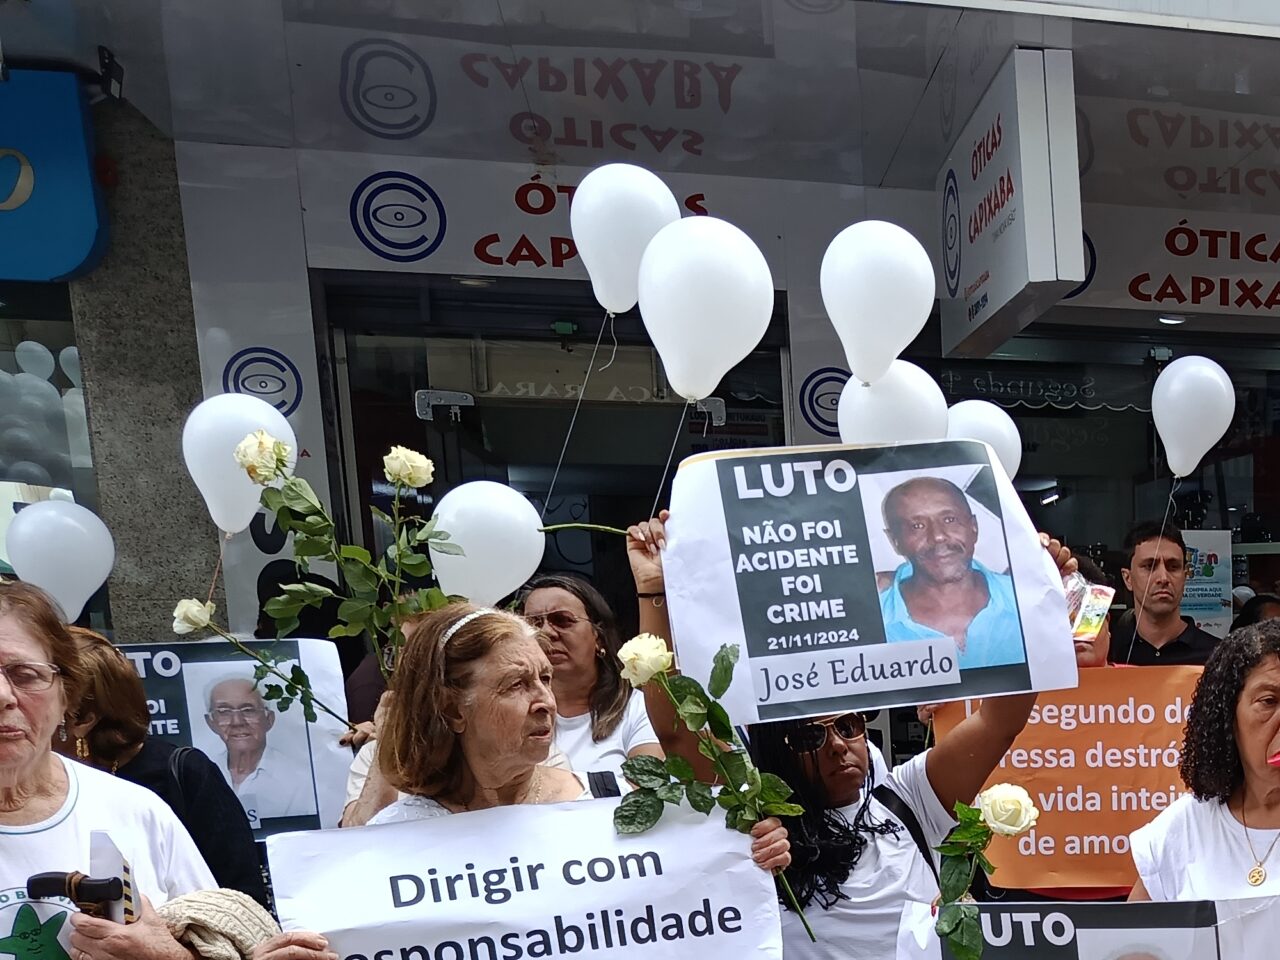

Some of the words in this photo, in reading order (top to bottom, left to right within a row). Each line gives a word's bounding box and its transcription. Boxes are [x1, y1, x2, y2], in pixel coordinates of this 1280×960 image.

[971, 112, 1003, 181] ÓTICAS
[968, 167, 1014, 244] CAPIXABA
[733, 459, 857, 500] LUTO
[741, 519, 797, 545] NÃO
[801, 519, 843, 541] FOI
[736, 544, 859, 573] ACIDENTE
[781, 574, 823, 596] FOI
[766, 598, 846, 624] CRIME
[767, 628, 860, 650] 21/11/2024
[759, 662, 820, 702] José
[827, 646, 953, 685] Eduardo
[1028, 697, 1155, 731] segundo
[1038, 785, 1101, 812] vida
[1018, 829, 1055, 856] de
[1064, 834, 1130, 855] amo
[389, 856, 545, 908] Dirigir
[561, 849, 663, 886] com
[980, 911, 1075, 947] UTO
